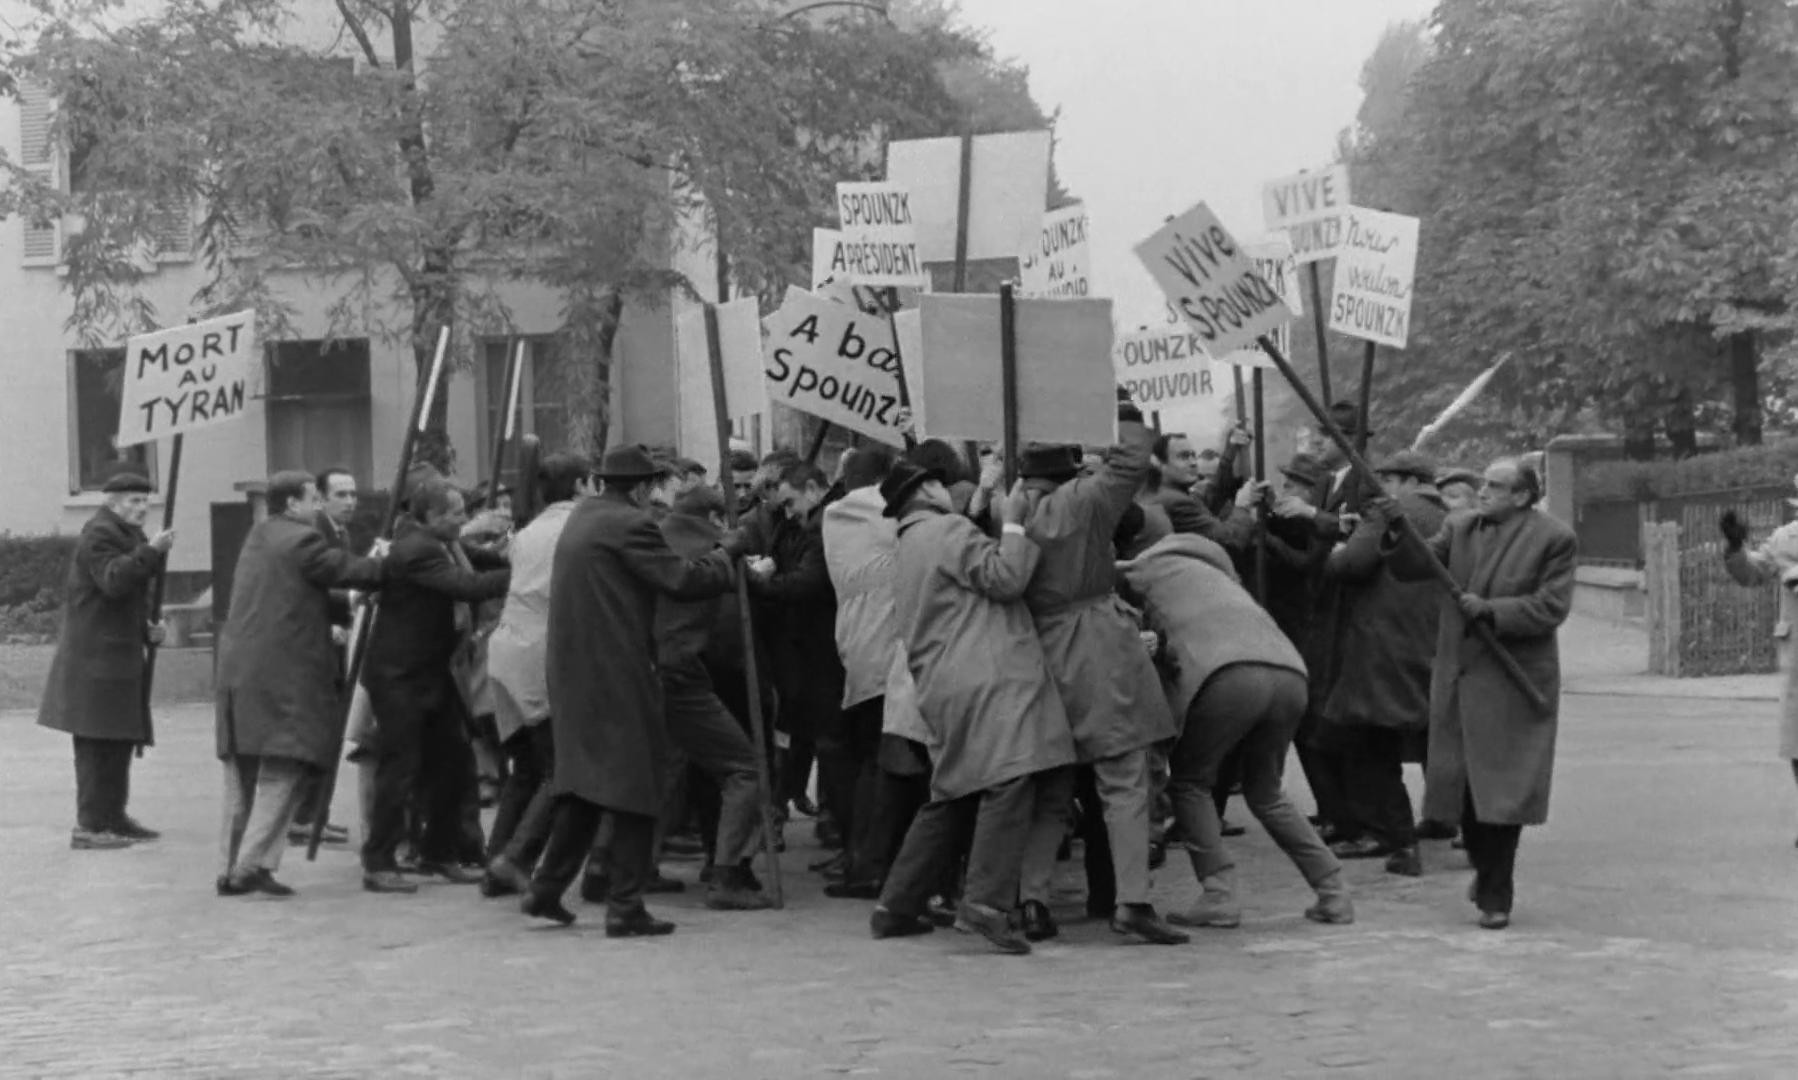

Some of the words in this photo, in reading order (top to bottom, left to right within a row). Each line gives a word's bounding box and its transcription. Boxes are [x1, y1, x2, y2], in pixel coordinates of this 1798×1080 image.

[841, 191, 912, 227] SPOUNZK
[1272, 174, 1337, 217] VIVE
[846, 234, 919, 275] PRÉSIDENT
[1047, 260, 1065, 282] AU
[1334, 293, 1407, 338] SPOUNZK
[137, 322, 246, 380] MORT
[790, 314, 820, 345] A
[838, 321, 900, 377] ba
[178, 363, 218, 389] AU
[765, 348, 905, 428] Spounz
[1125, 369, 1215, 403] POUVOIR
[139, 378, 246, 433] TYRAN
